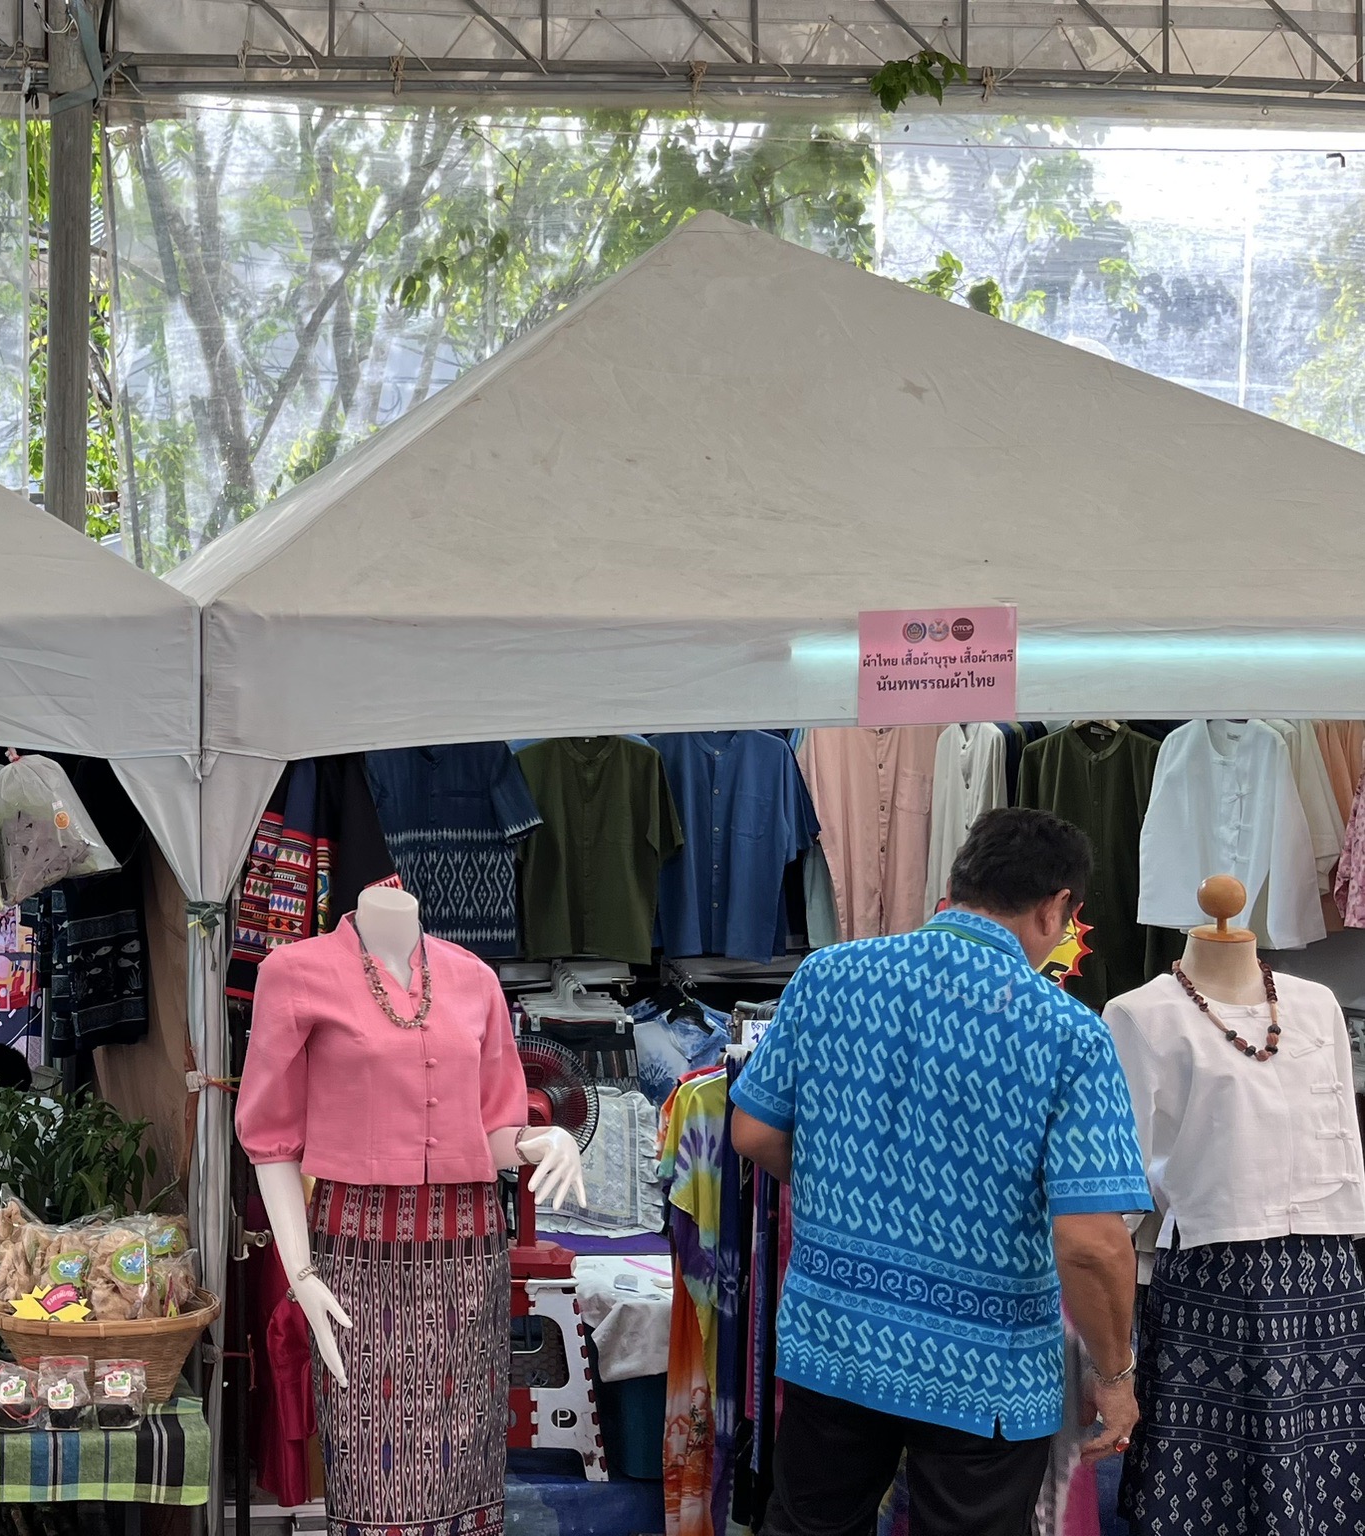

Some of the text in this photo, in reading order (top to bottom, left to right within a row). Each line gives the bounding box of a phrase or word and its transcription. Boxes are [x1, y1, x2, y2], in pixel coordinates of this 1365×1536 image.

[953, 624, 973, 632] OTOP
[863, 646, 1014, 669] ผ้าไทย เสื้อผ้าบุรุษ เสื้อผ้าสตรี
[876, 670, 996, 692] นันทพรรณผ้าไทย
